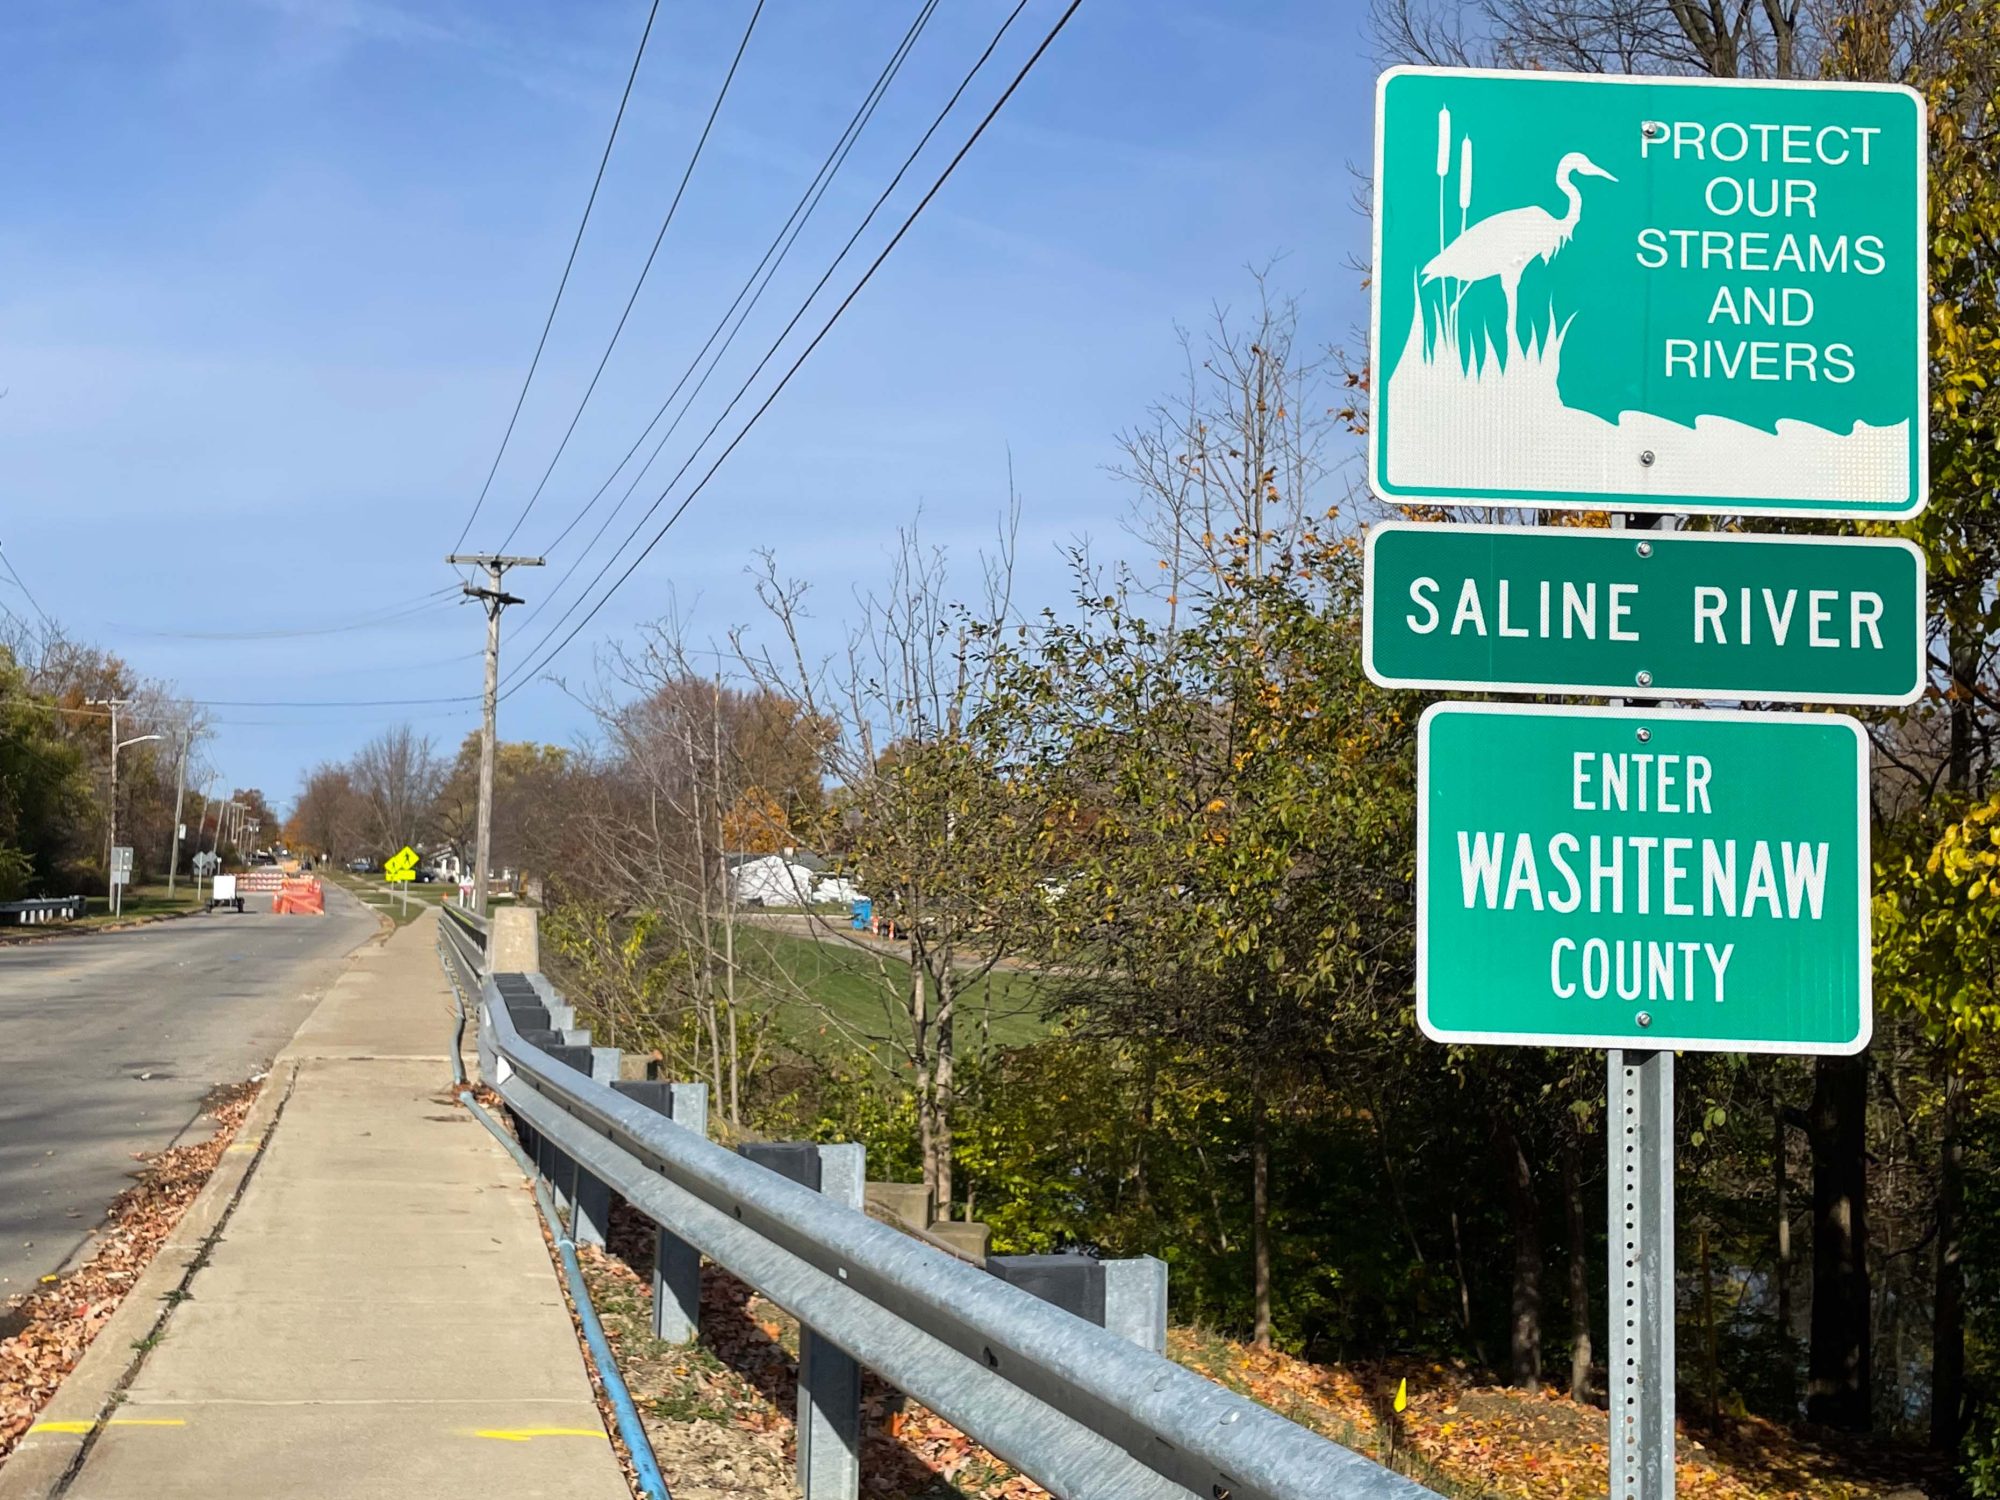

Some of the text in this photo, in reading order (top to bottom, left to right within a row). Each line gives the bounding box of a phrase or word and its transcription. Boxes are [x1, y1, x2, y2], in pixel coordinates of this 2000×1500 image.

[1641, 120, 1881, 165] PROTECT
[1705, 176, 1817, 218] OUR
[1636, 228, 1886, 275] STREAMS
[1707, 286, 1814, 326] AND
[1665, 339, 1855, 383] RIVERS
[1406, 576, 1884, 649] SALINE RIVER
[1573, 751, 1712, 814] ENTER
[1457, 831, 1829, 920] WASHTENAW
[1551, 937, 1734, 1002] COUNTY
